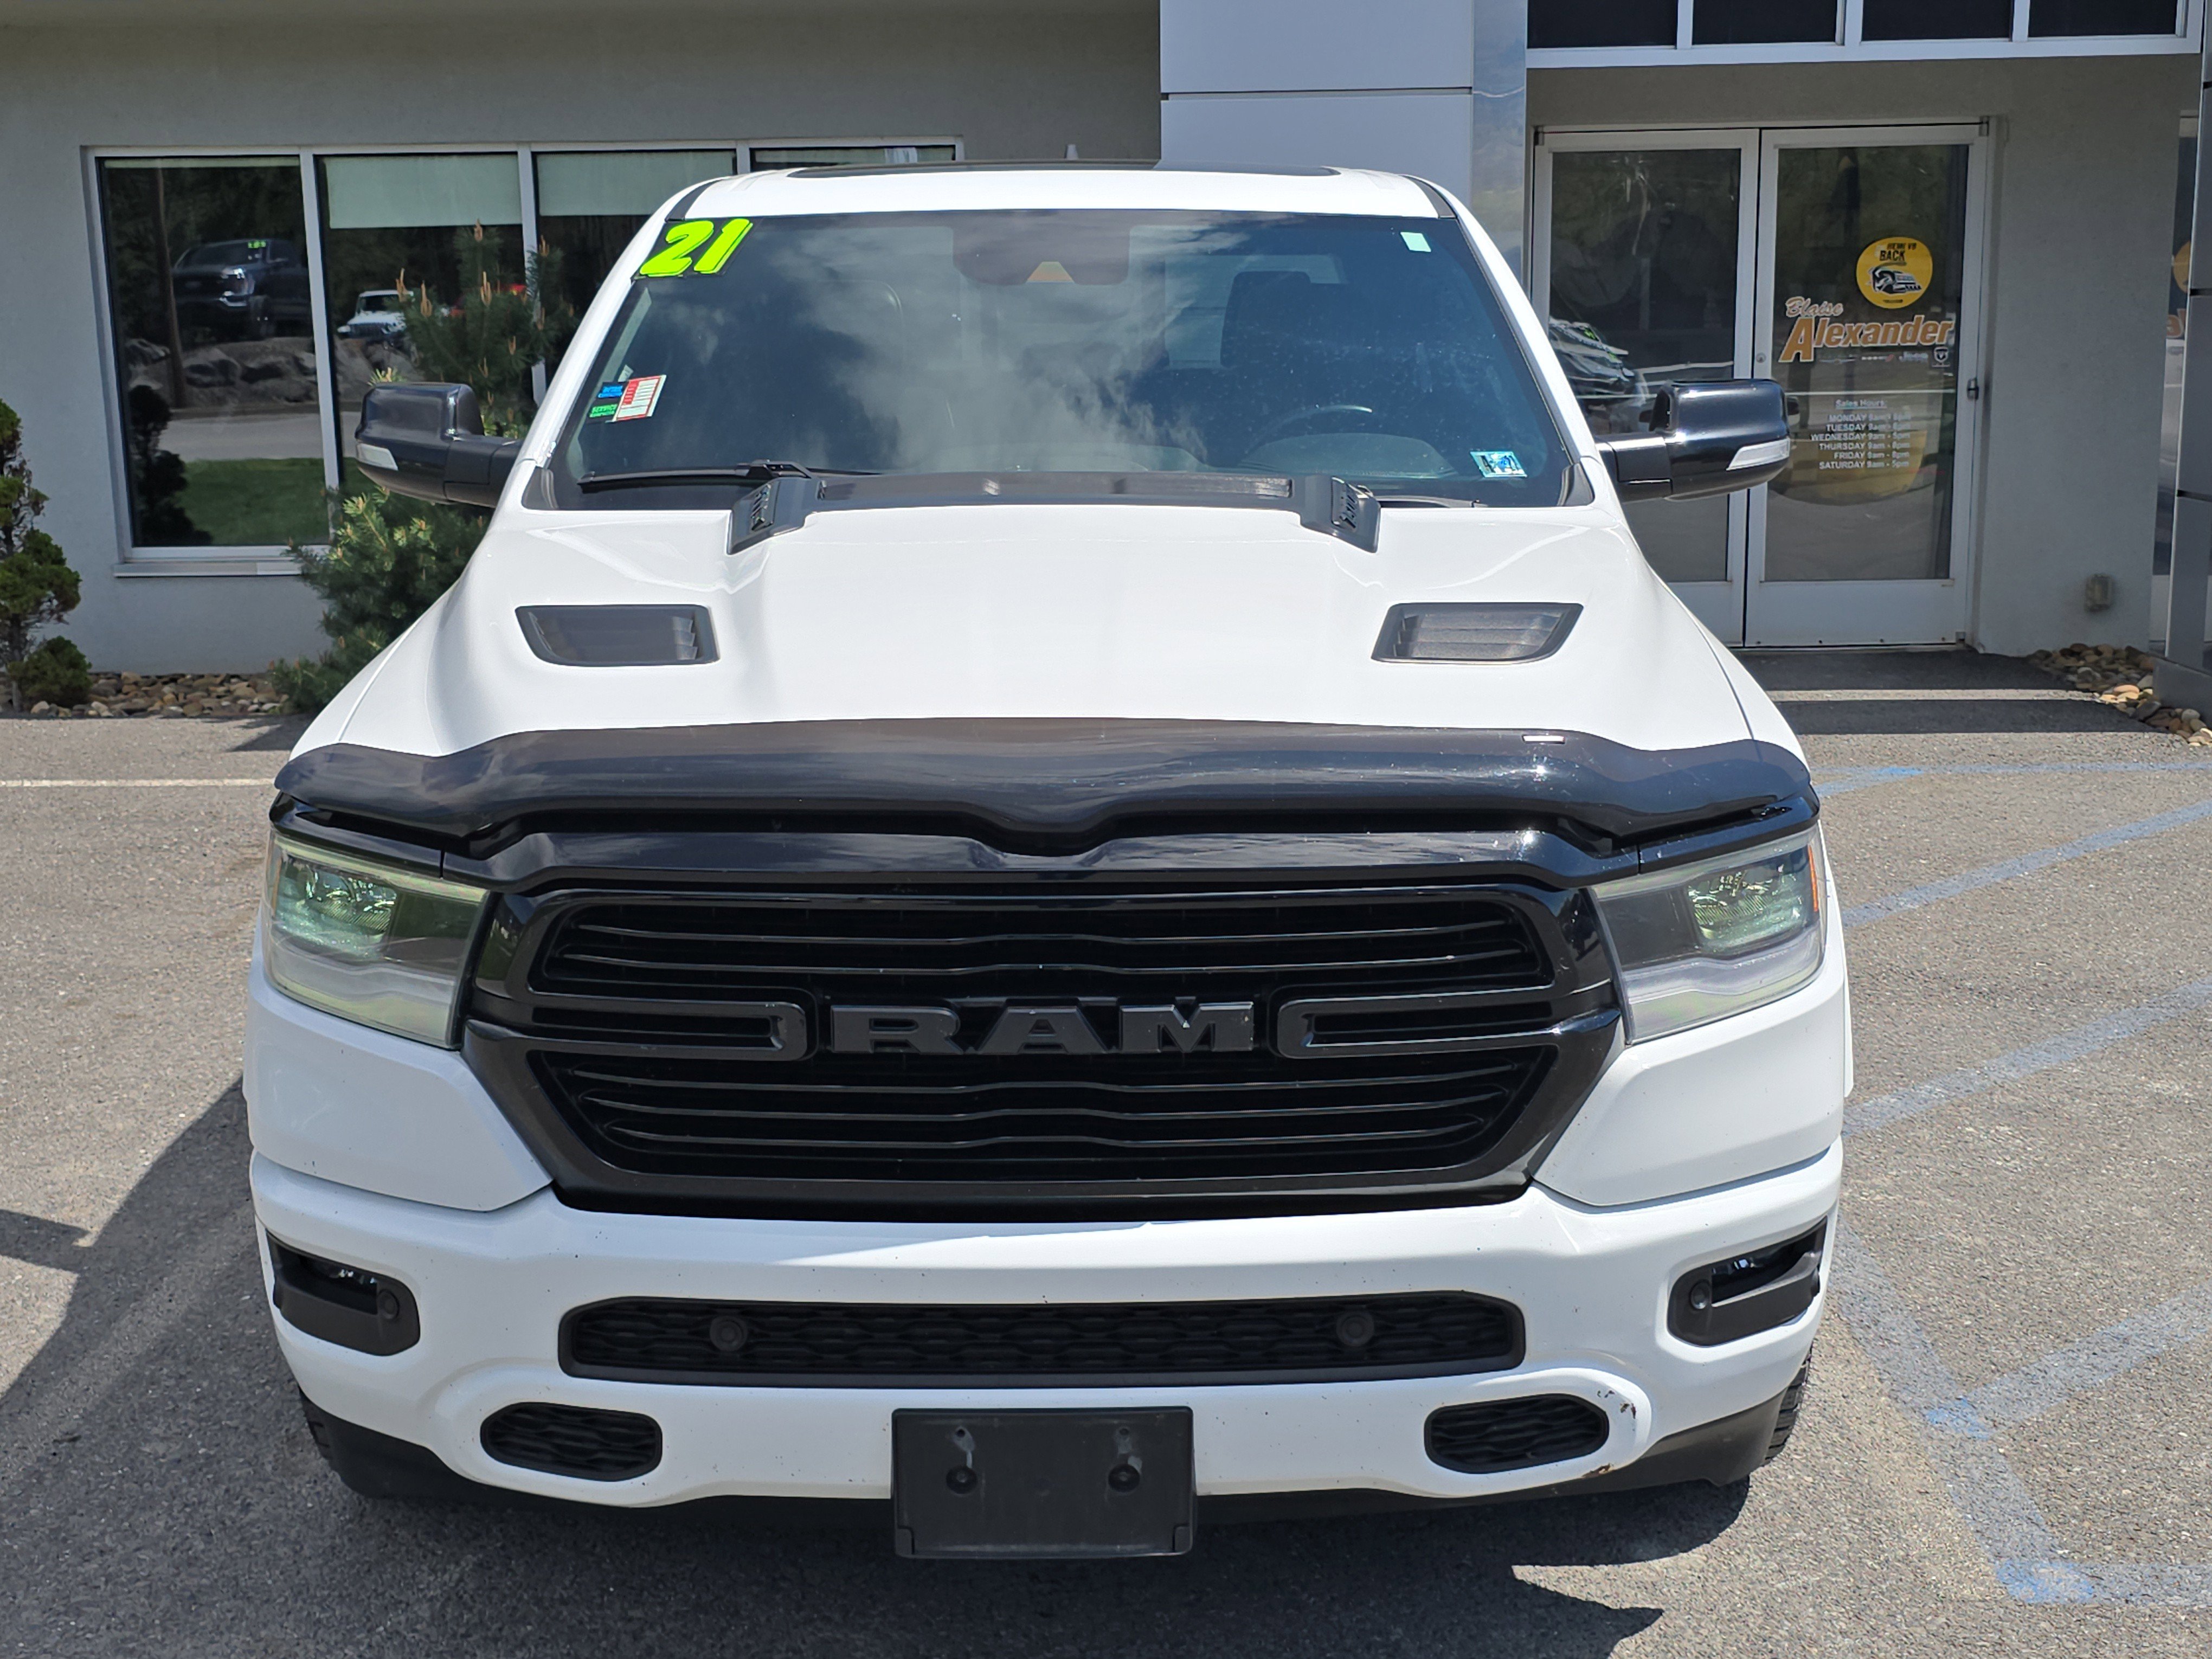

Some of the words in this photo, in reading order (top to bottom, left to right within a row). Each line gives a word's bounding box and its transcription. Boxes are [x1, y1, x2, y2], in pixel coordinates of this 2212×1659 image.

[640, 218, 753, 276] 21
[1879, 250, 1905, 261] BACK
[1785, 296, 1843, 317] Blaise
[1778, 314, 1954, 362] Alexander
[1828, 414, 1867, 422] MONDAY
[1826, 423, 1867, 432] TUESDAY
[1811, 433, 1867, 441] WEDNESDAY
[1819, 442, 1866, 450] THURSDAY
[1834, 451, 1866, 459] FRIDAY
[1819, 461, 1866, 470] SATURDAY
[831, 1001, 1255, 1054] RAM
